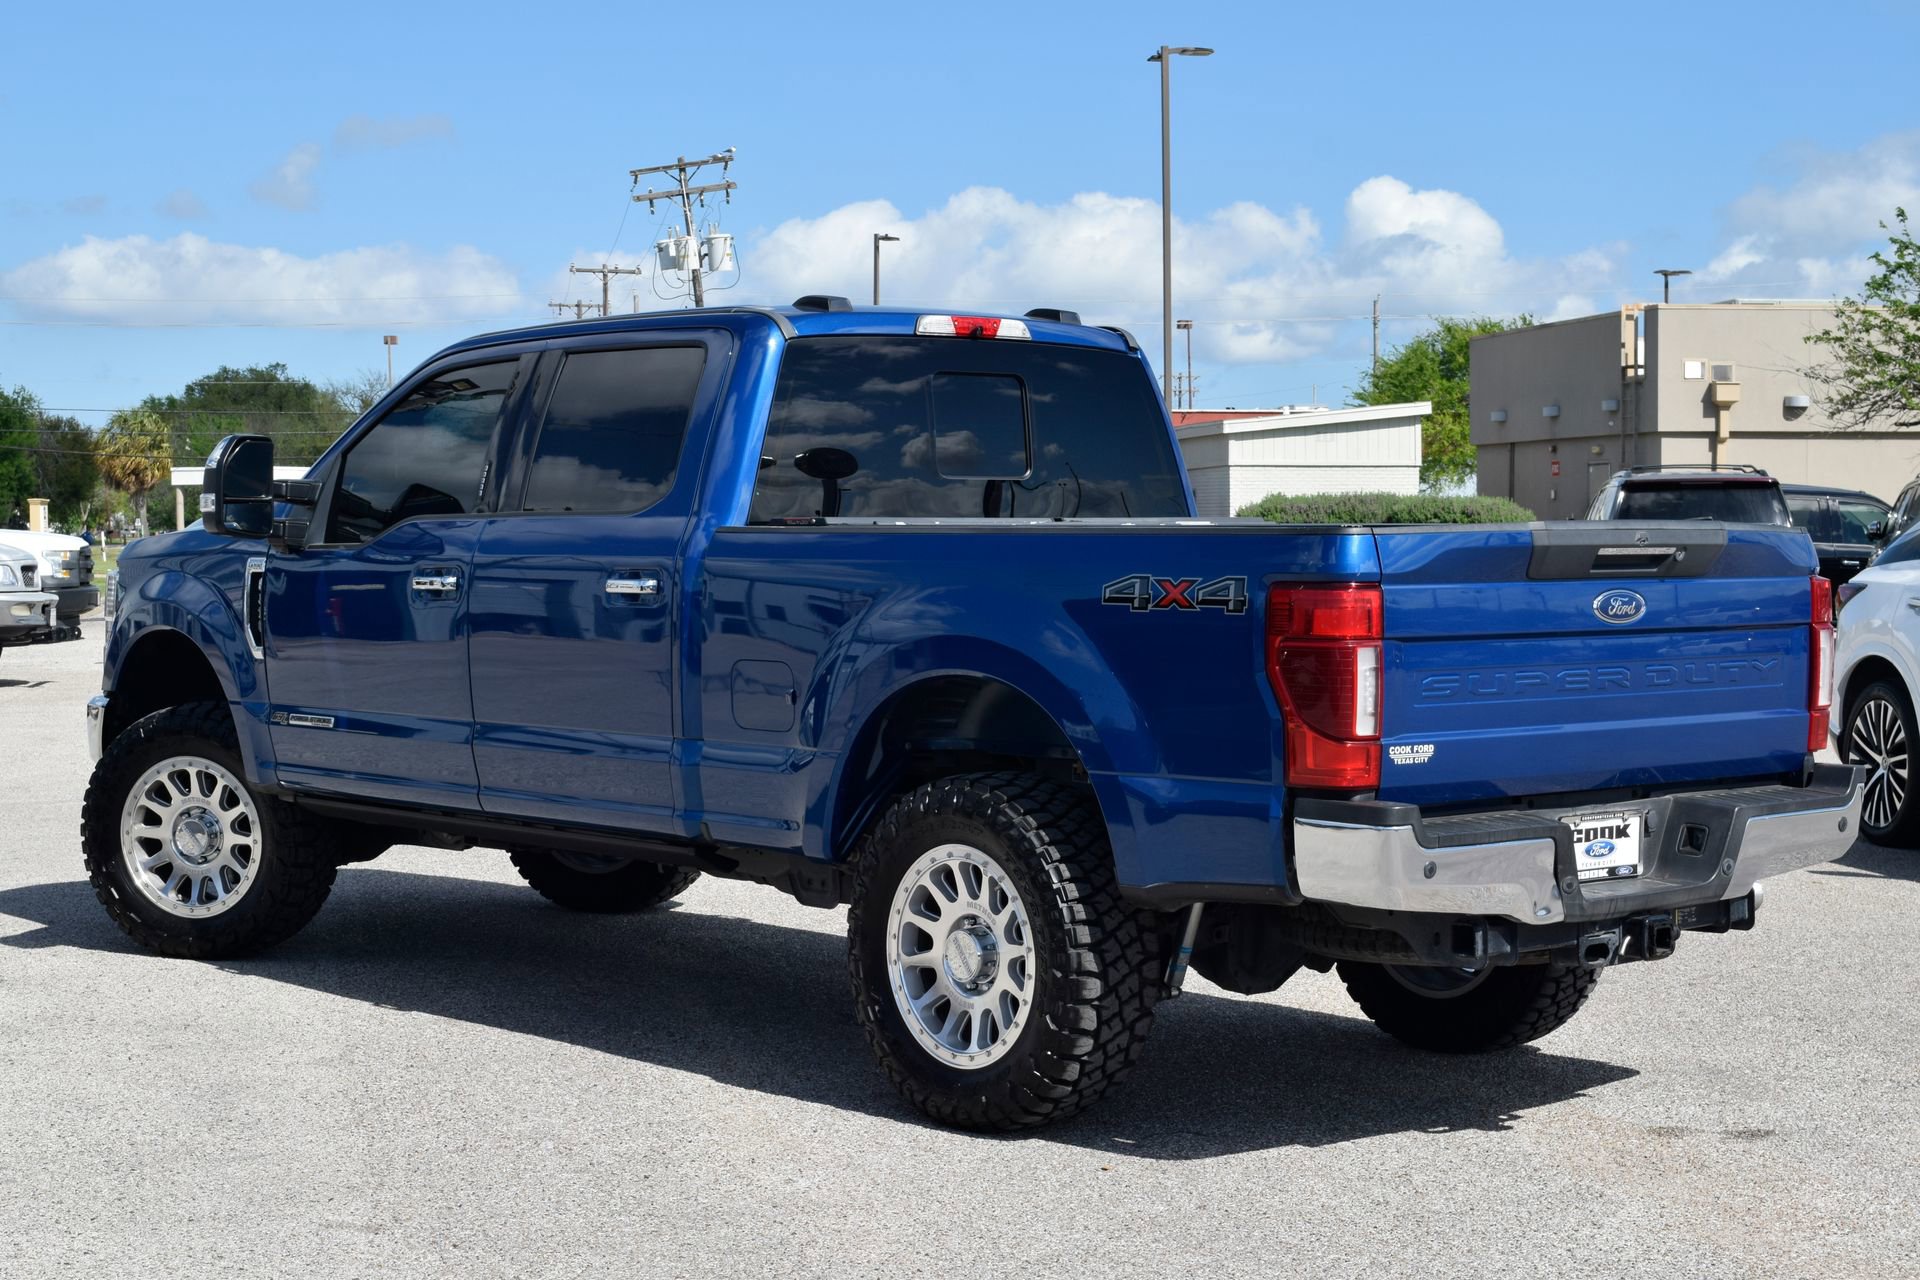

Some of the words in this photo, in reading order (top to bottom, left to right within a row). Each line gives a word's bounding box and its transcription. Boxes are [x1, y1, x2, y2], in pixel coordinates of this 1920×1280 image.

[1608, 596, 1636, 615] Ford
[1421, 666, 1631, 698] SUPER
[1646, 659, 1779, 687] DUTY
[1389, 745, 1412, 754] COOK
[1413, 744, 1435, 753] FORD
[1572, 824, 1631, 843] COOK
[1589, 842, 1610, 856] Ford
